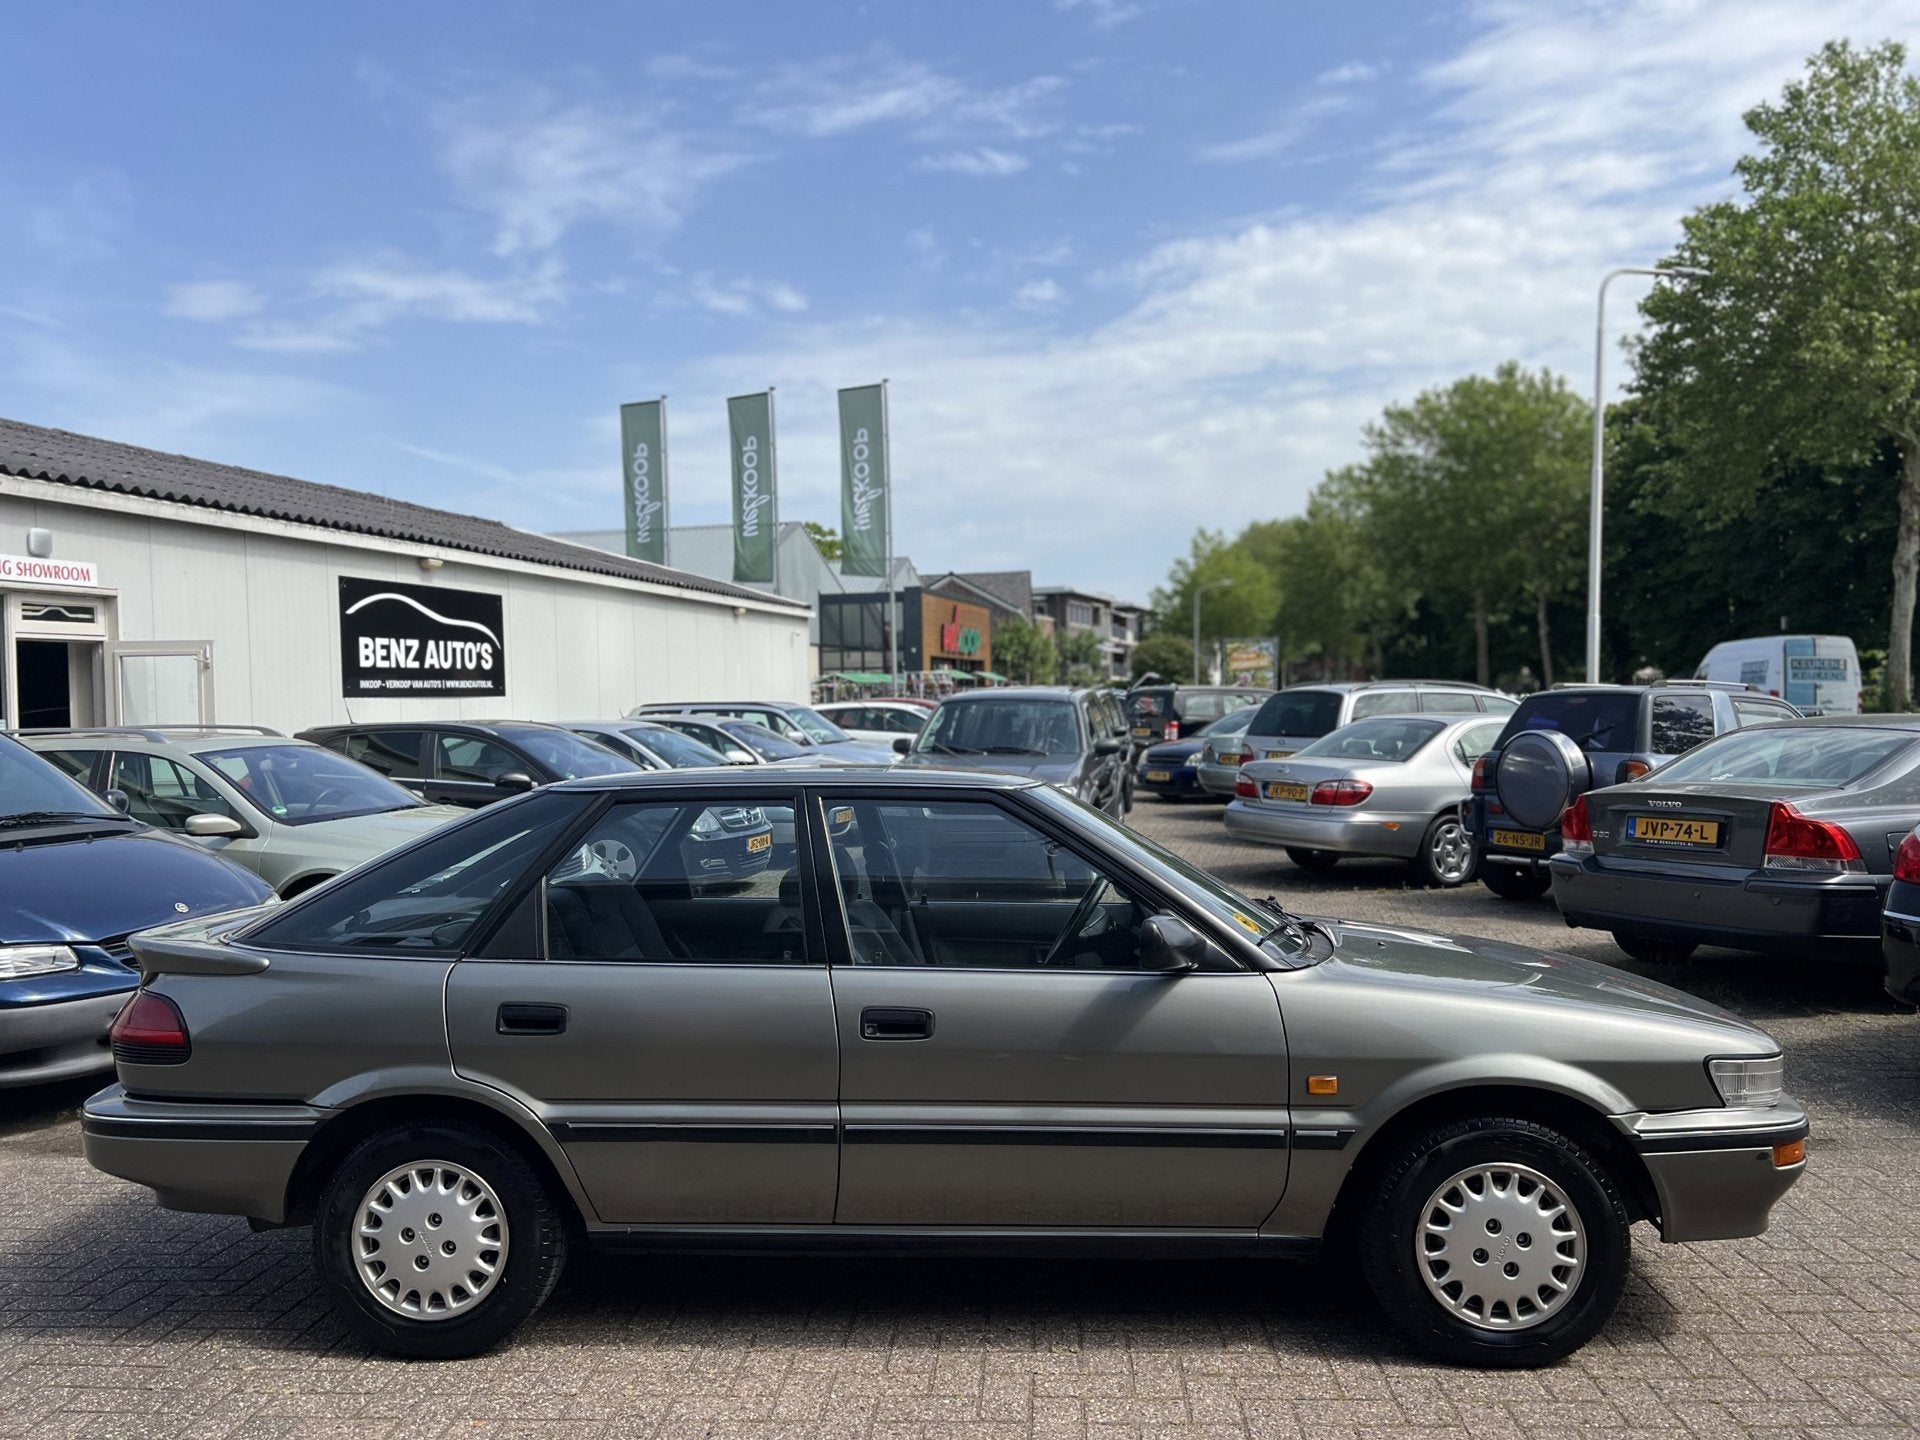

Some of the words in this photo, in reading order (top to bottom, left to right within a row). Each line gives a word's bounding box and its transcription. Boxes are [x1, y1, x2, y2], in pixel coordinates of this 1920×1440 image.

[16, 561, 91, 582] SHOWROOM
[358, 636, 420, 669] BENZ
[424, 640, 493, 670] AUTO'S
[360, 679, 382, 689] INKOOP
[385, 679, 411, 689] VERKOOP
[411, 679, 423, 689] VAN
[1647, 800, 1682, 808] VOLVO
[1496, 832, 1542, 848] 26-NS-JR
[1640, 821, 1709, 841] JVP-74-L
